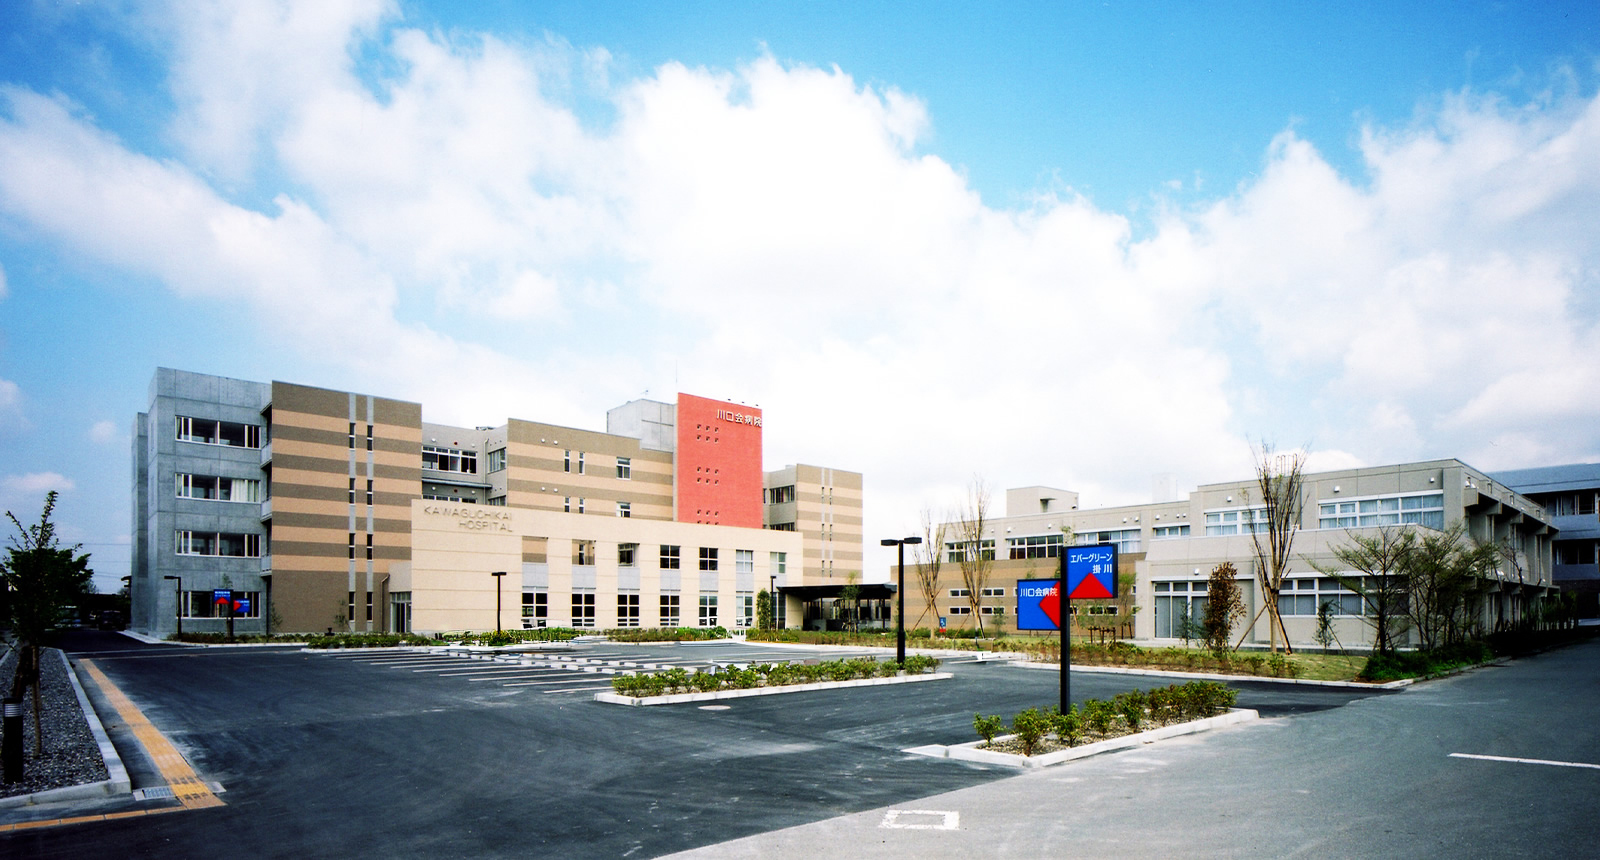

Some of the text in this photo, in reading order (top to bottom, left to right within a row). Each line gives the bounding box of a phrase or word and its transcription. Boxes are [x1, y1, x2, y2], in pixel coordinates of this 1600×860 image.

[716, 408, 762, 428] 川口会病院
[458, 520, 513, 533] HOSPITAL
[1070, 553, 1113, 563] エバーグリーン
[1020, 587, 1058, 597] 川口会病院
